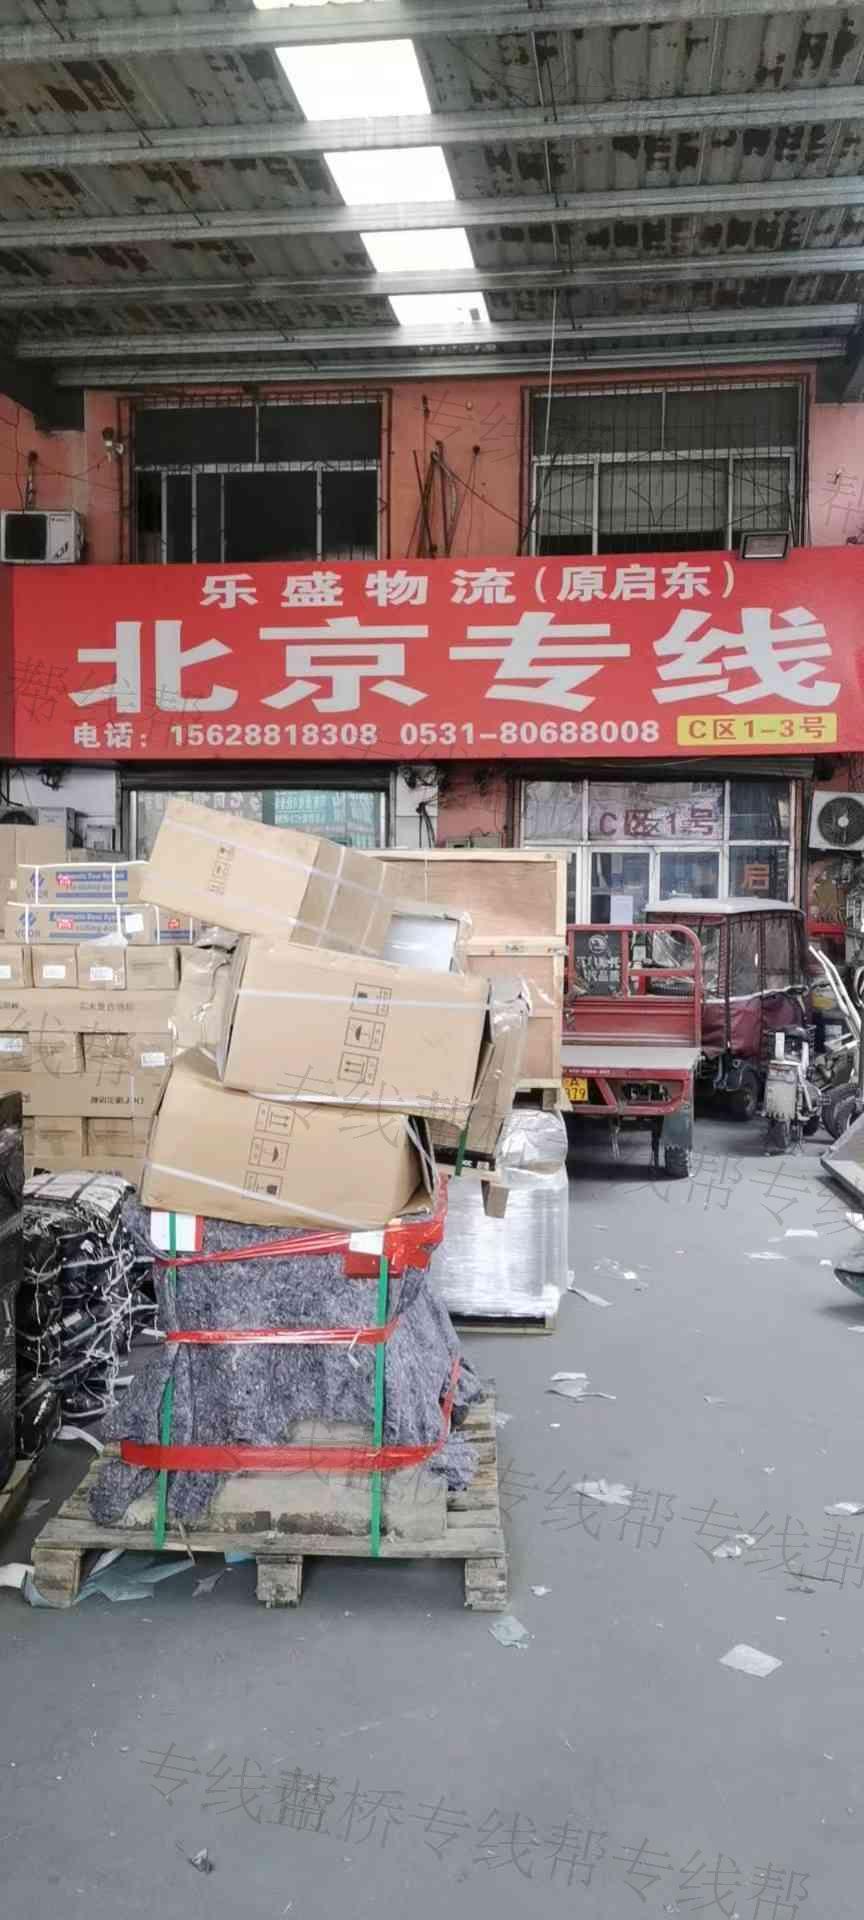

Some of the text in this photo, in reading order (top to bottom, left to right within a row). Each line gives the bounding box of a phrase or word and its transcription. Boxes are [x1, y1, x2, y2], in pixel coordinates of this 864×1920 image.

[68, 607, 842, 714] 北京专线
[170, 723, 378, 746] 15628818308
[400, 720, 660, 746] 0531-80688008
[687, 716, 827, 740] C区1-3号
[599, 803, 718, 838] C区1号
